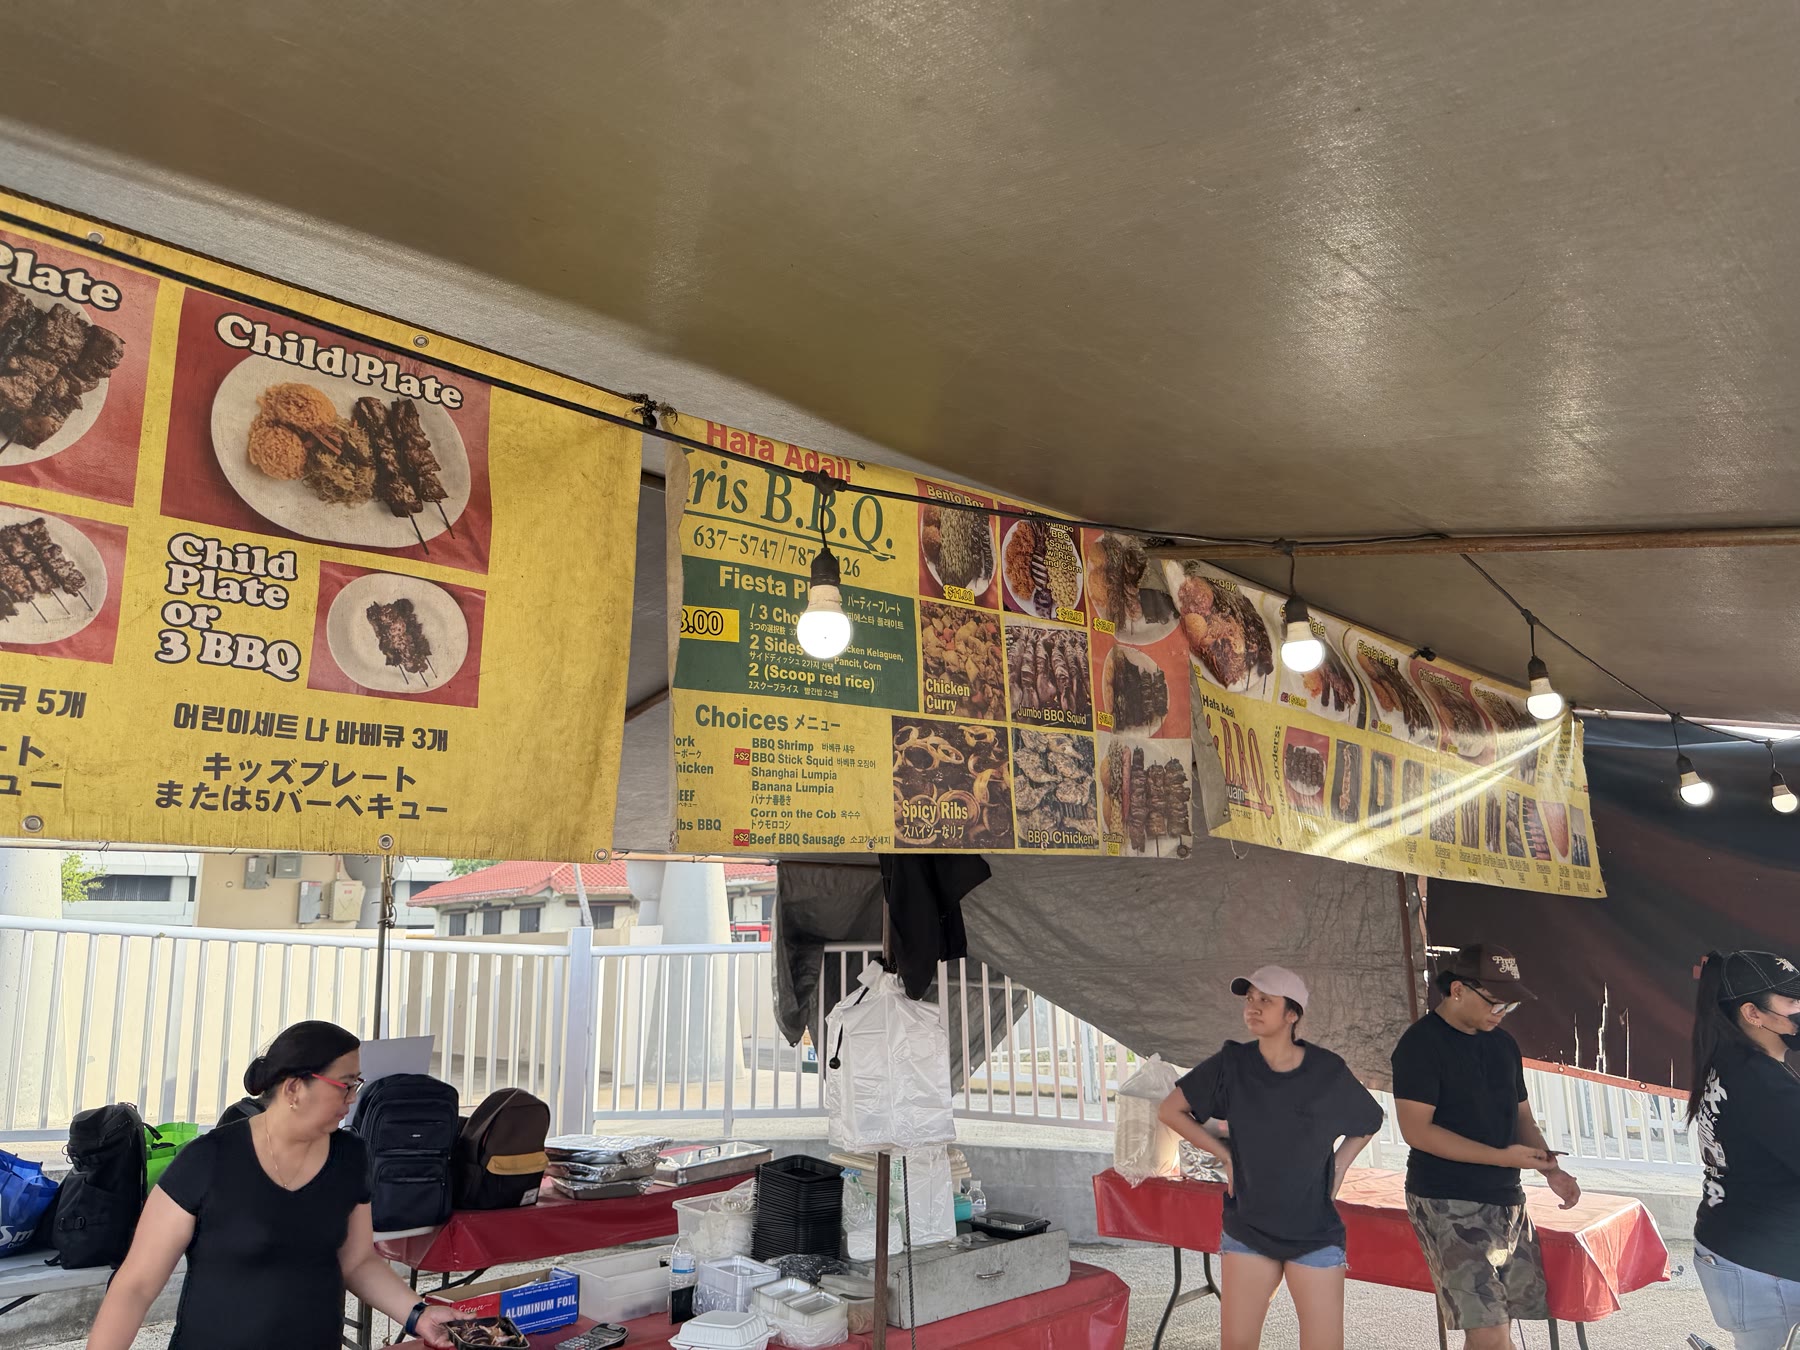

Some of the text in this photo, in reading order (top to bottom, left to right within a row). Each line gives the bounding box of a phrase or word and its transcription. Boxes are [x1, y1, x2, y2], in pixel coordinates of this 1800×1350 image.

[215, 313, 465, 410] Child Plate
[785, 443, 851, 483] Adai!
[926, 484, 963, 504] Bento
[761, 467, 893, 563] B.B.Q.
[1049, 539, 1073, 552] Squid
[1050, 529, 1071, 543] BBQ
[167, 532, 298, 581] Child
[1043, 559, 1083, 574] and Corn
[1058, 551, 1077, 563] Rice
[165, 561, 290, 610] Plate
[719, 565, 787, 601] Fiesta
[161, 600, 222, 630] or
[759, 604, 769, 621] 3
[749, 633, 805, 657] 2 Sides
[866, 646, 904, 664] Kelaguen,
[155, 629, 301, 683] 3 BBQ
[833, 655, 883, 672] Pancit, Corn
[748, 662, 876, 694] 2 (Scoop red rice)
[925, 677, 971, 698] Chicken
[37, 689, 87, 718] 5개
[926, 694, 957, 714] Curry
[695, 704, 841, 732] Choices メニュー
[1017, 705, 1042, 723] Jumbo
[1043, 710, 1065, 725] BBQ
[1066, 711, 1087, 727] Squid
[173, 702, 448, 751] 어린이세트 나 바베큐 3개
[674, 735, 696, 748] ork
[752, 737, 775, 752] BBQ
[777, 738, 814, 753] Shrimp
[676, 761, 714, 775] hicken
[752, 752, 776, 764] BBQ
[777, 754, 803, 767] Stick
[805, 755, 834, 768] Squid
[203, 752, 417, 792] キッズプレート
[751, 766, 838, 782] Shanghai Lumpia
[679, 789, 696, 802] EEF
[751, 780, 835, 796] Banana Lumpia
[155, 779, 448, 819] または5バーベキュー
[750, 807, 778, 819] Corn
[780, 810, 793, 819] on
[795, 808, 813, 820] the
[815, 808, 837, 821] Cob
[902, 799, 969, 824] Spicy Ribs
[677, 818, 722, 832] ibs BBQ
[749, 832, 777, 845] Beef
[778, 832, 801, 847] BBQ
[802, 833, 846, 848] Sausage
[1027, 828, 1050, 845] BBQ
[1052, 829, 1093, 846] Chicken
[505, 1294, 577, 1319] ALUMINUM FOIL
